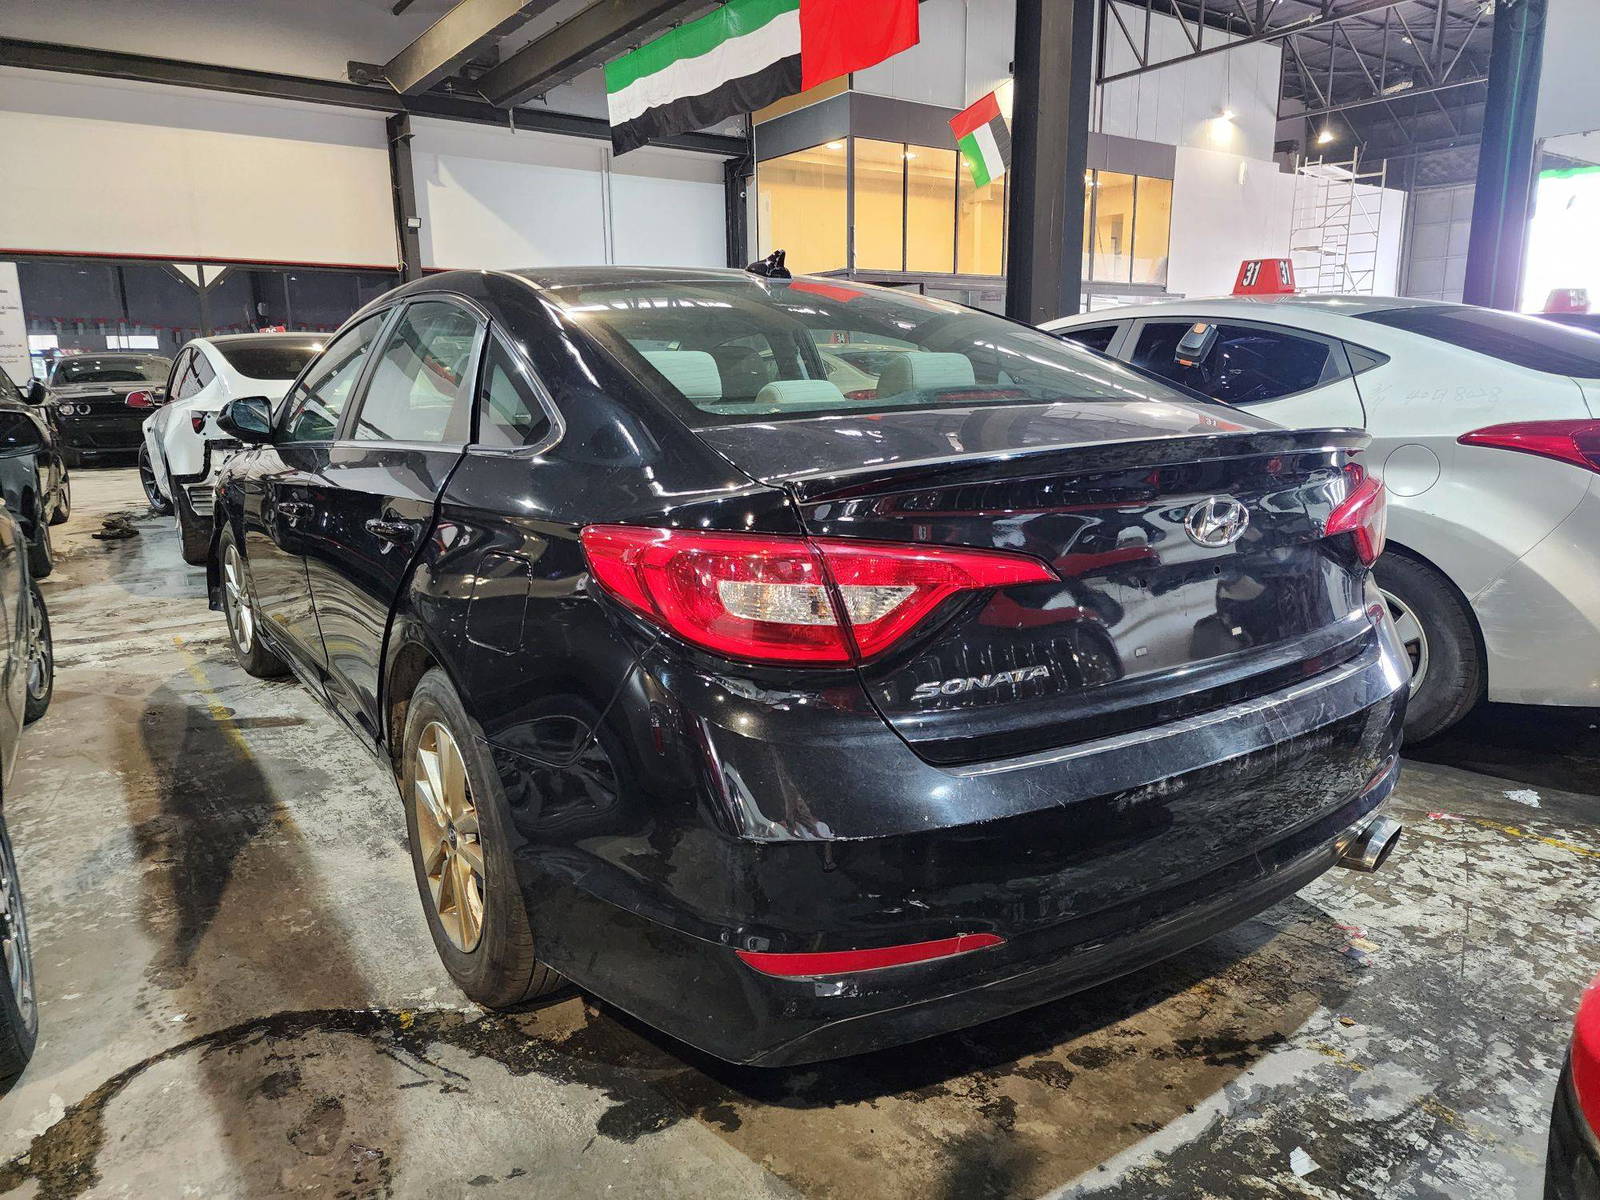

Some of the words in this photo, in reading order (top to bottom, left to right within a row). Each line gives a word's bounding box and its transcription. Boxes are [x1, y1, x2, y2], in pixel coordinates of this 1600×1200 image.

[1241, 261, 1262, 287] 31
[1279, 260, 1291, 285] 31
[911, 665, 1050, 701] SONATA
